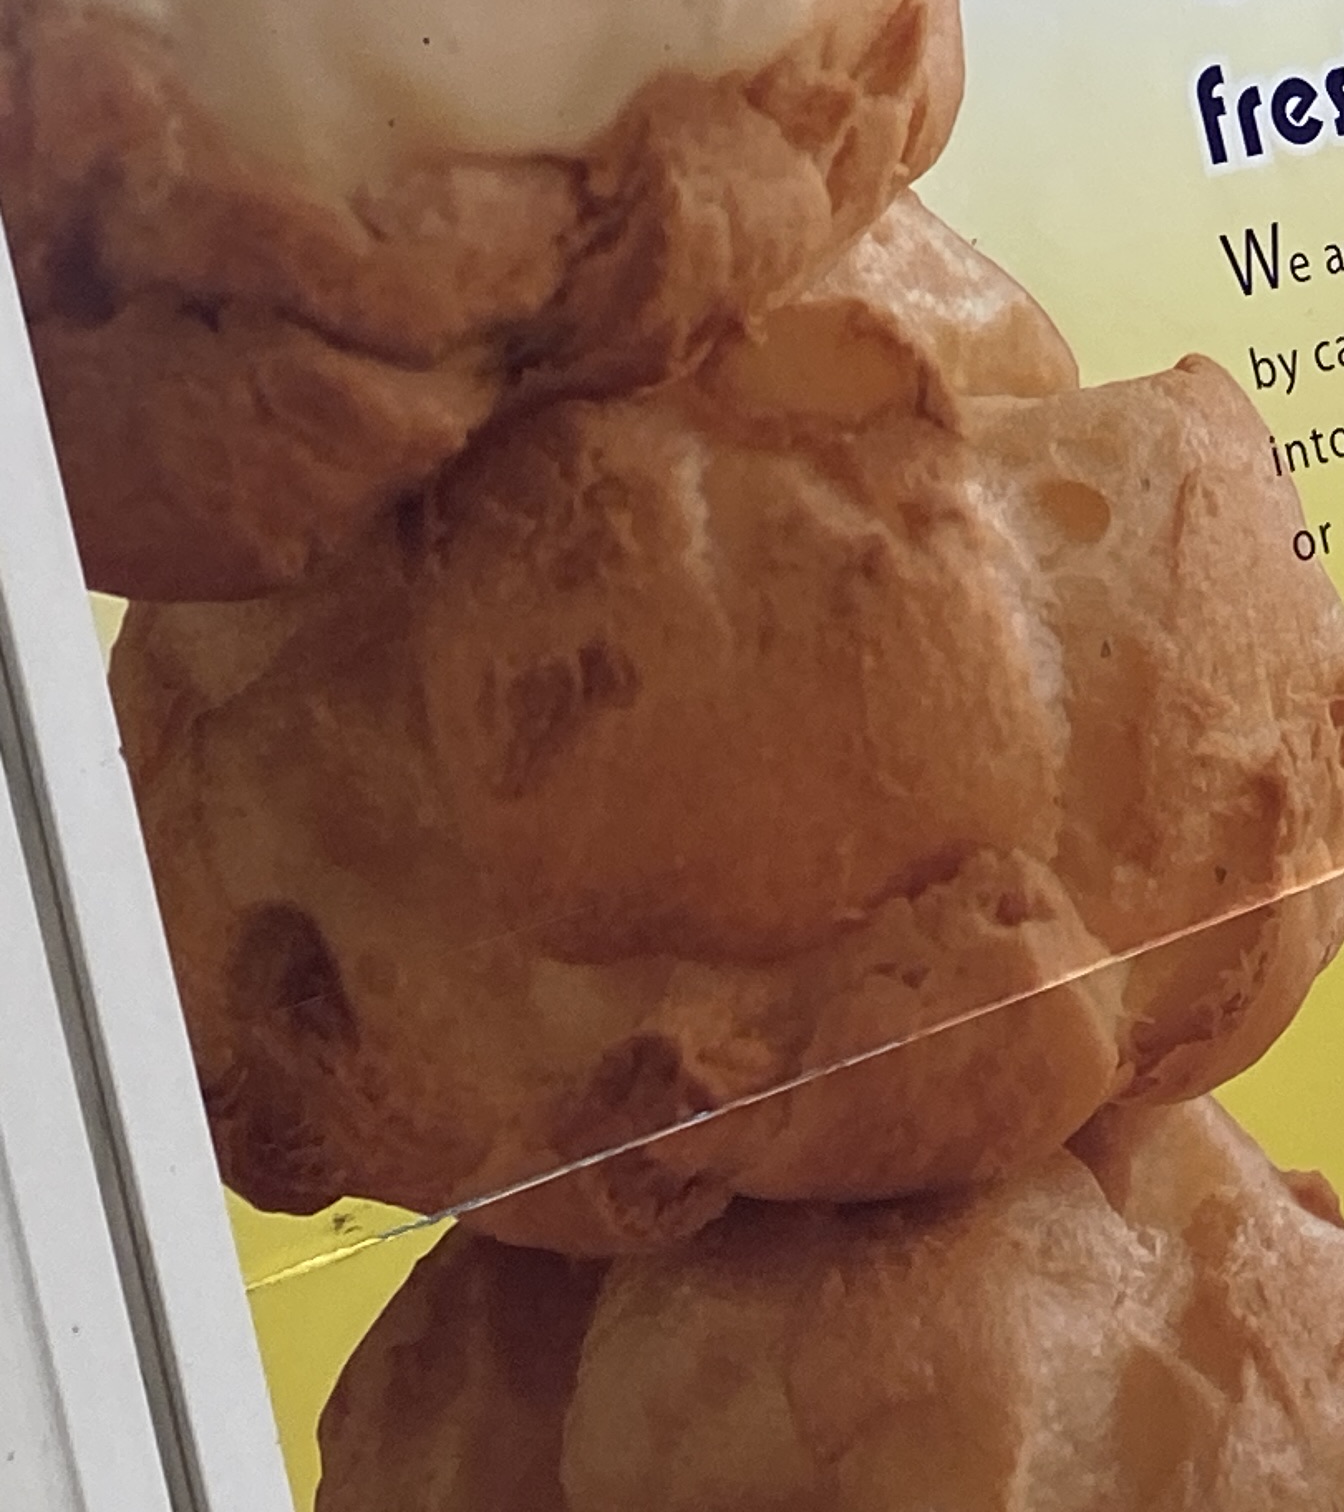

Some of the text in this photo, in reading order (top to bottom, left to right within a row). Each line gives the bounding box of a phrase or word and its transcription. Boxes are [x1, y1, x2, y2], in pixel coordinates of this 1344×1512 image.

[1220, 222, 1310, 295] We
[1250, 348, 1296, 394] by
[1293, 522, 1330, 561] or
